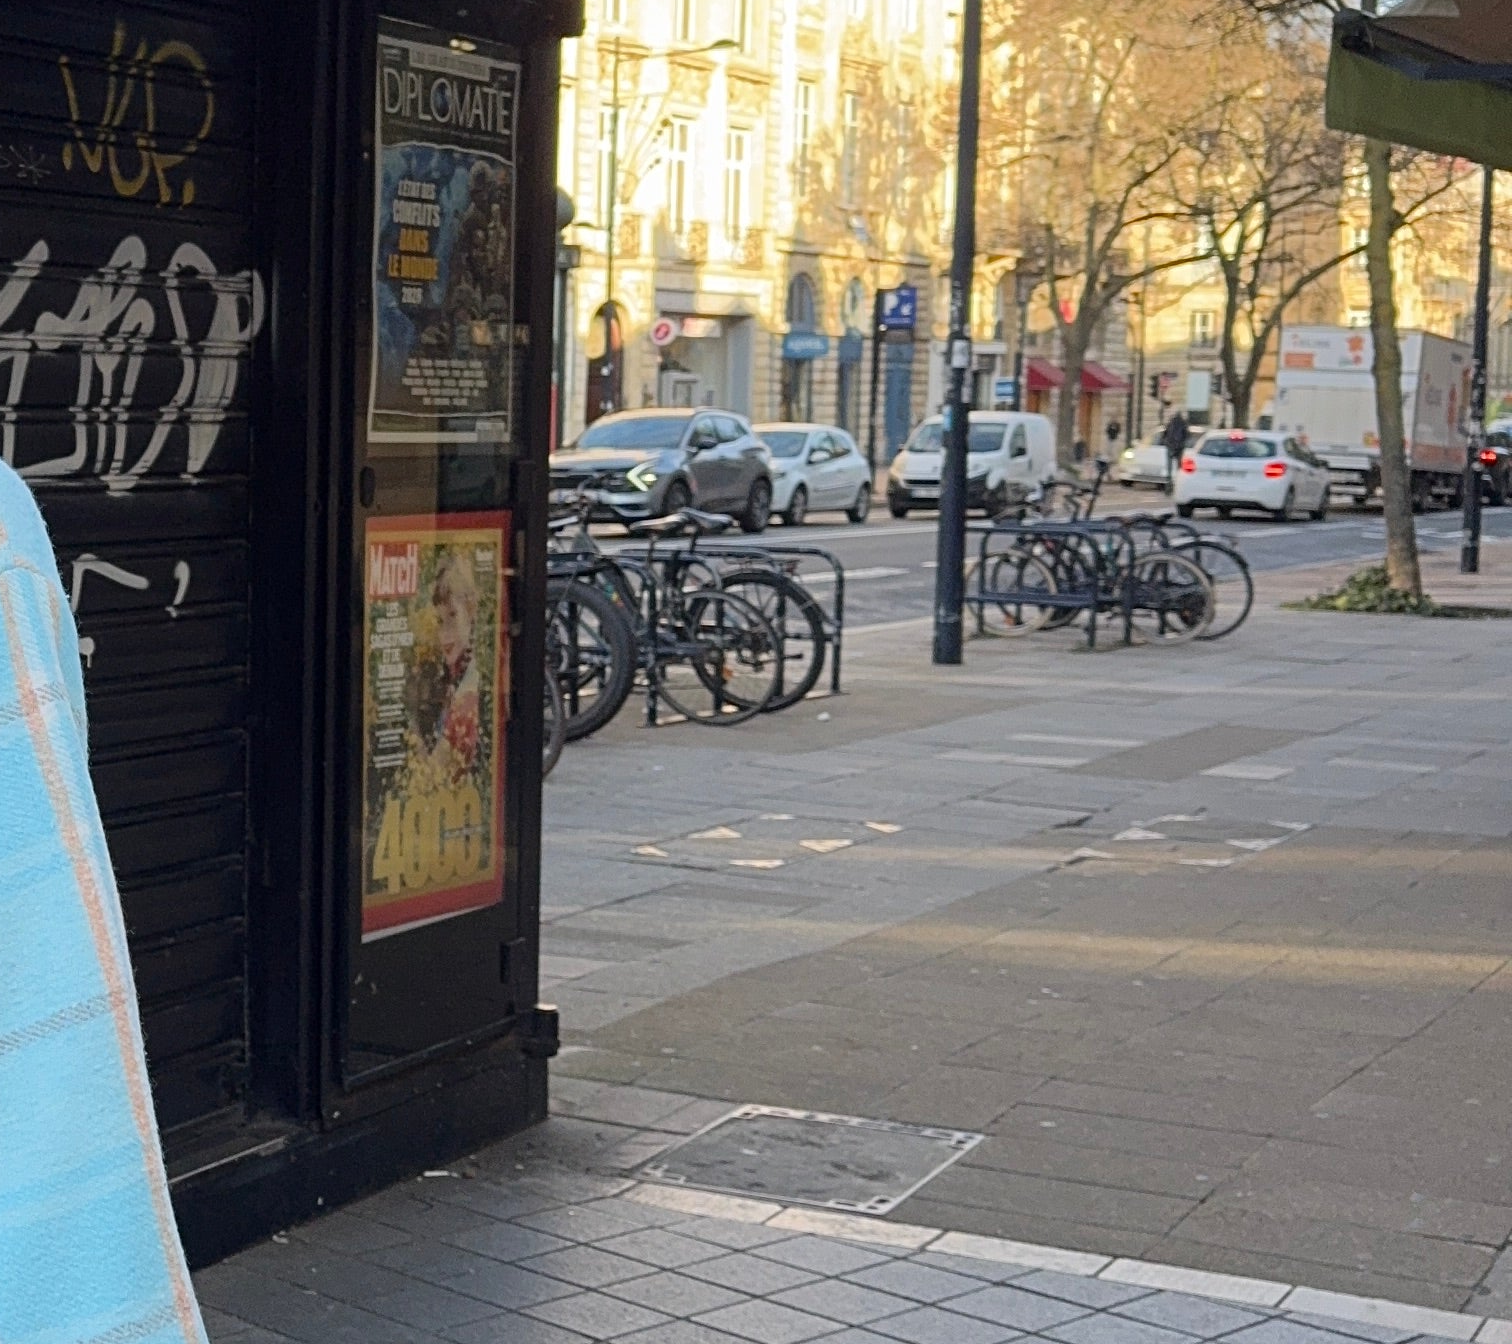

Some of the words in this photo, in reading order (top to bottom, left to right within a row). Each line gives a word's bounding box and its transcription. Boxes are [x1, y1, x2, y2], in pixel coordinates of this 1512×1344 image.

[383, 66, 512, 136] DIPLOMATIE
[369, 543, 418, 596] MATCH
[372, 786, 482, 896] 4000
